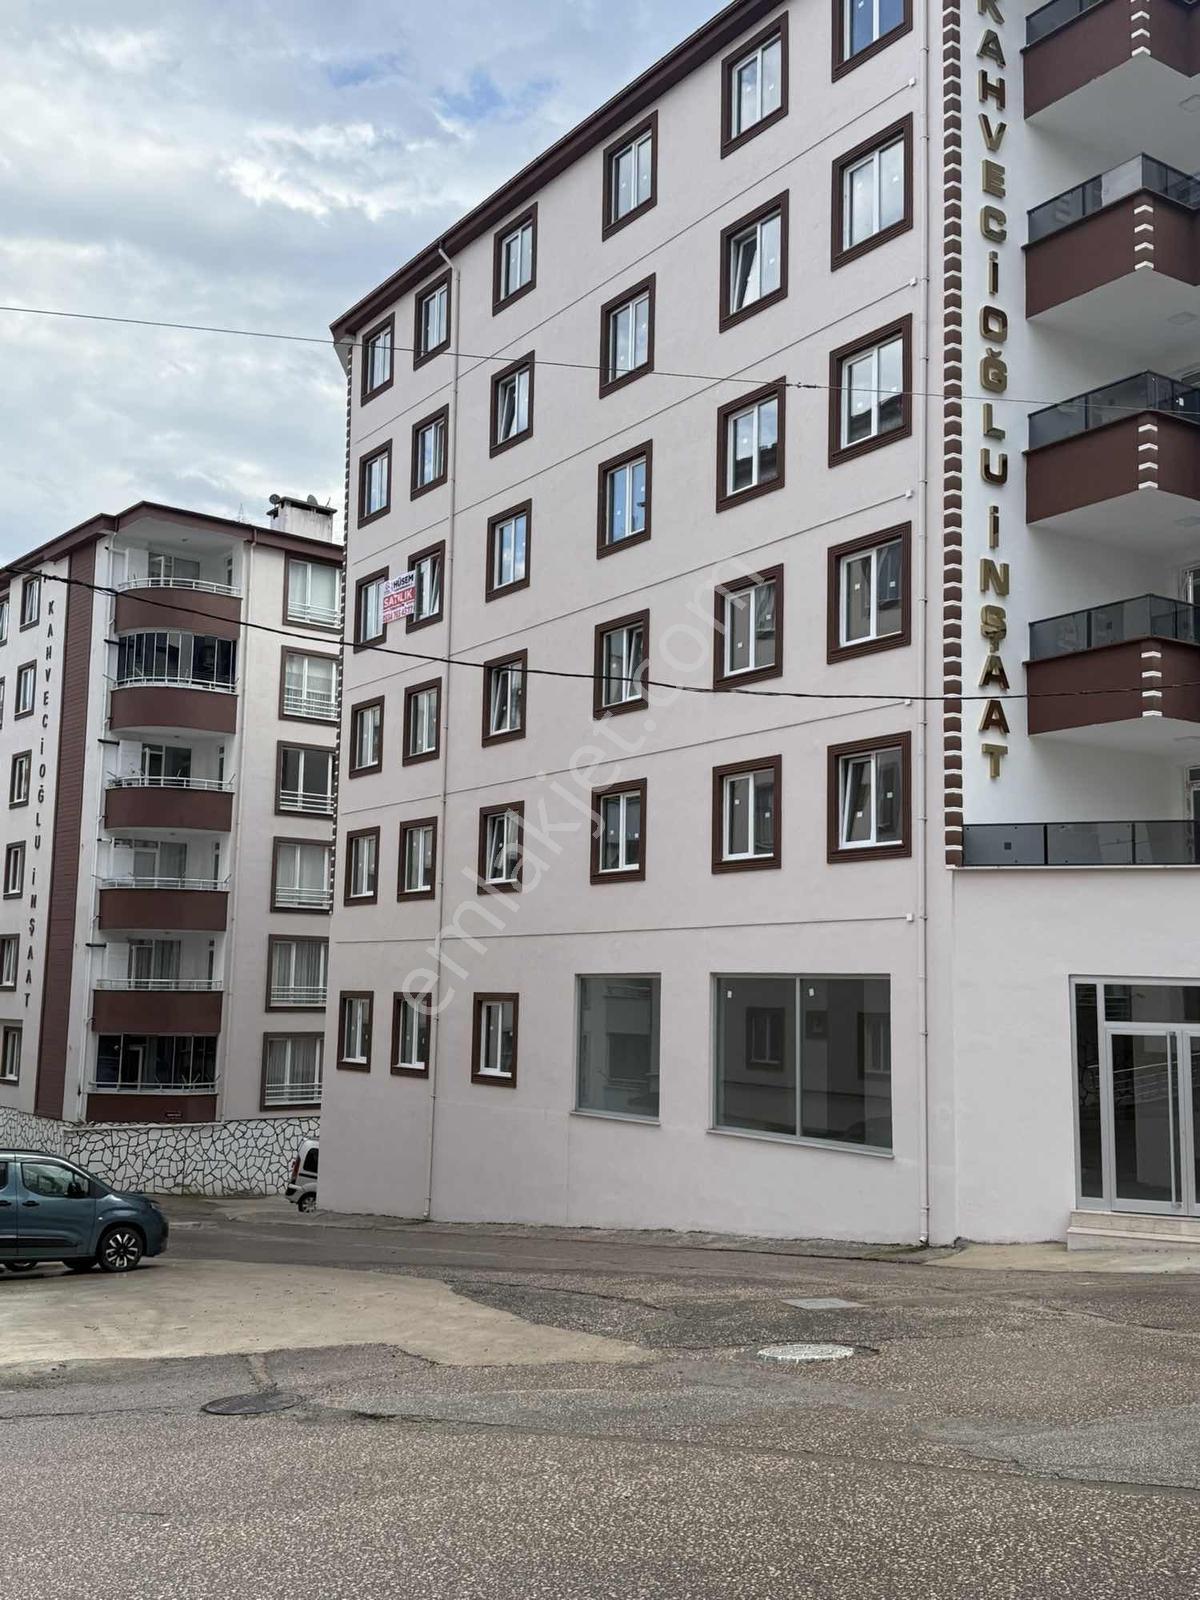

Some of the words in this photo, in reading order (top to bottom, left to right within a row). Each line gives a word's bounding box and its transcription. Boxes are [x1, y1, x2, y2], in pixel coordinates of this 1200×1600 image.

[383, 588, 412, 607] SATILIK
[978, 505, 1010, 777] İNŞAAT
[34, 600, 54, 849] KAHVECİOĞLU
[24, 868, 37, 1008] İNŞAAT
